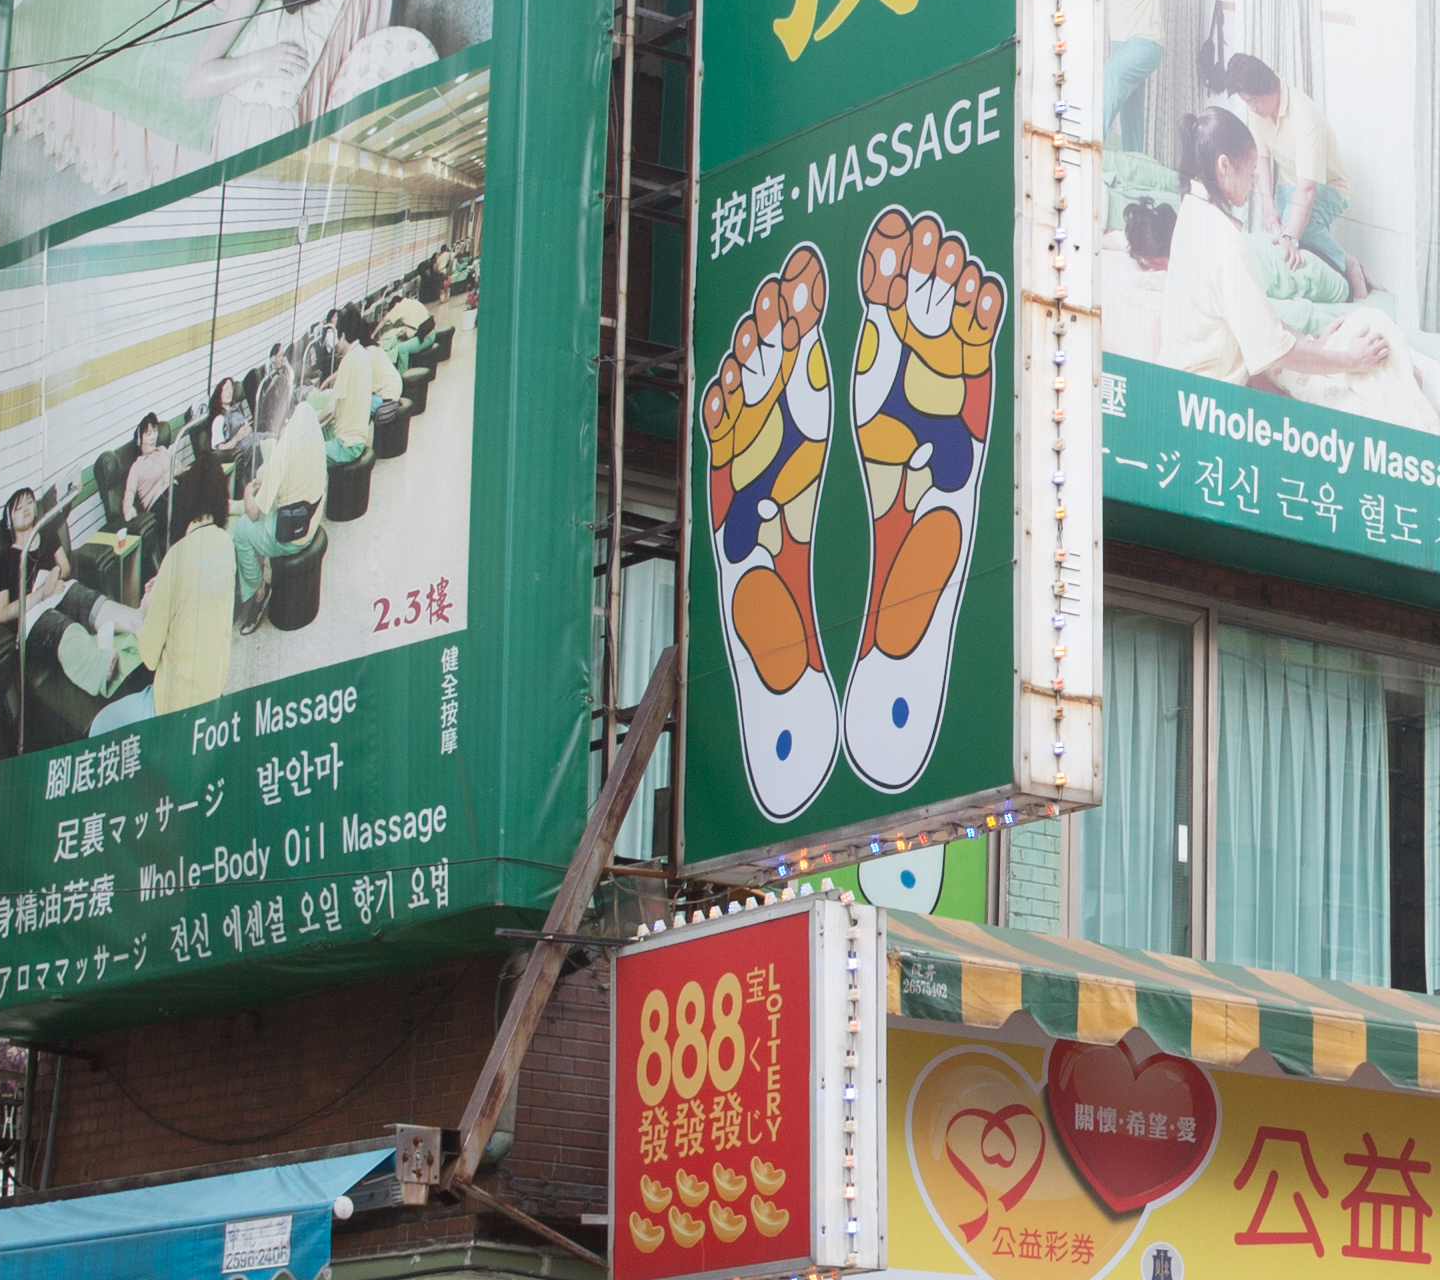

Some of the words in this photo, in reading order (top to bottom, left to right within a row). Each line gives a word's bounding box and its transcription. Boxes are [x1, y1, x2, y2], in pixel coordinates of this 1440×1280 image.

[1177, 390, 1354, 476] Whole-body
[1194, 456, 1261, 515] 전신
[1276, 476, 1343, 534] 근육
[1358, 489, 1421, 547] 혈도
[372, 576, 454, 634] 2.3樓
[192, 713, 241, 756] Foot
[254, 684, 358, 737] Massage
[440, 646, 459, 756] 健全按摩
[45, 733, 142, 800] 腳底按摩
[257, 742, 344, 806] 발안마
[53, 776, 226, 864] 足裏マッサージ
[139, 842, 271, 903] Whole-Body
[284, 825, 327, 869] Oil
[342, 803, 448, 857] Massage
[170, 917, 211, 963] 전신
[222, 894, 287, 953] 에센셜
[298, 882, 340, 935] 오일
[351, 870, 395, 926] 향기
[406, 857, 451, 911] 요법
[903, 978, 948, 999] 26575402
[636, 970, 747, 1108] 888
[766, 963, 784, 1143] LOTTERY
[638, 1094, 743, 1166] 發發發
[992, 1225, 1096, 1265] 公益彩券
